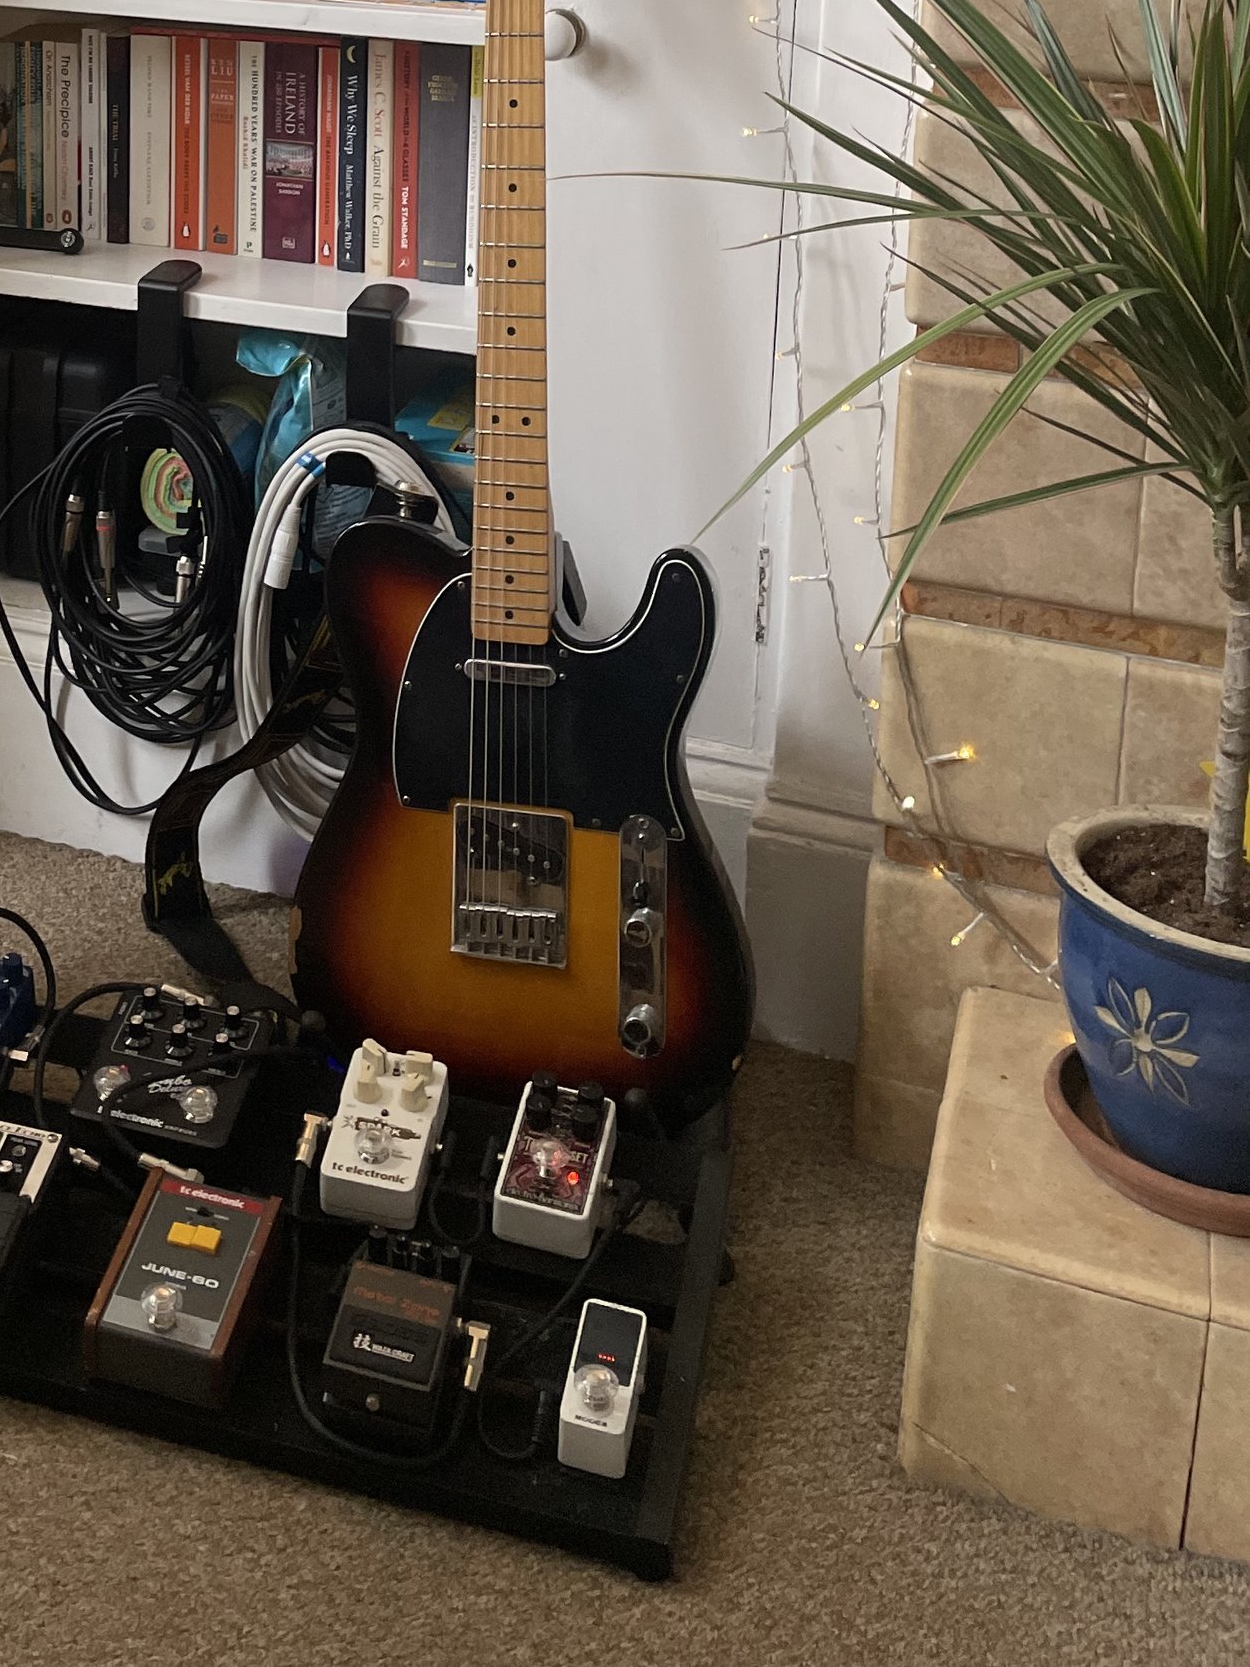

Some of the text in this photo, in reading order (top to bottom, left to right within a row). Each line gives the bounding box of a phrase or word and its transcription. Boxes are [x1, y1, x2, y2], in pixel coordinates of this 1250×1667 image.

[60, 55, 71, 76] The
[211, 67, 233, 76] LIU
[250, 69, 259, 113] HUNDRED
[298, 81, 306, 119] HISTORY
[346, 74, 359, 101] Why
[59, 79, 71, 138] Precipice
[285, 72, 297, 135] IRELAND
[346, 103, 358, 122] We
[297, 121, 305, 135] OF
[402, 107, 410, 136] WORLD
[343, 124, 357, 155] Sleep
[371, 53, 387, 249] James C. Scott Against the Grain
[250, 147, 258, 168] WAR
[401, 149, 410, 183] GLASSES
[468, 124, 478, 192] INTRODUCTION
[249, 169, 258, 183] ON
[344, 164, 354, 200] Matthew
[249, 184, 258, 233] PALESTINE
[401, 186, 409, 205] TOM
[344, 231, 353, 250] PhD
[400, 206, 409, 249] STANDAGE
[110, 1109, 165, 1128] electronic
[332, 1161, 406, 1185] tc electronic
[180, 1185, 245, 1209] tc electronic
[141, 1262, 220, 1290] JUNE-60
